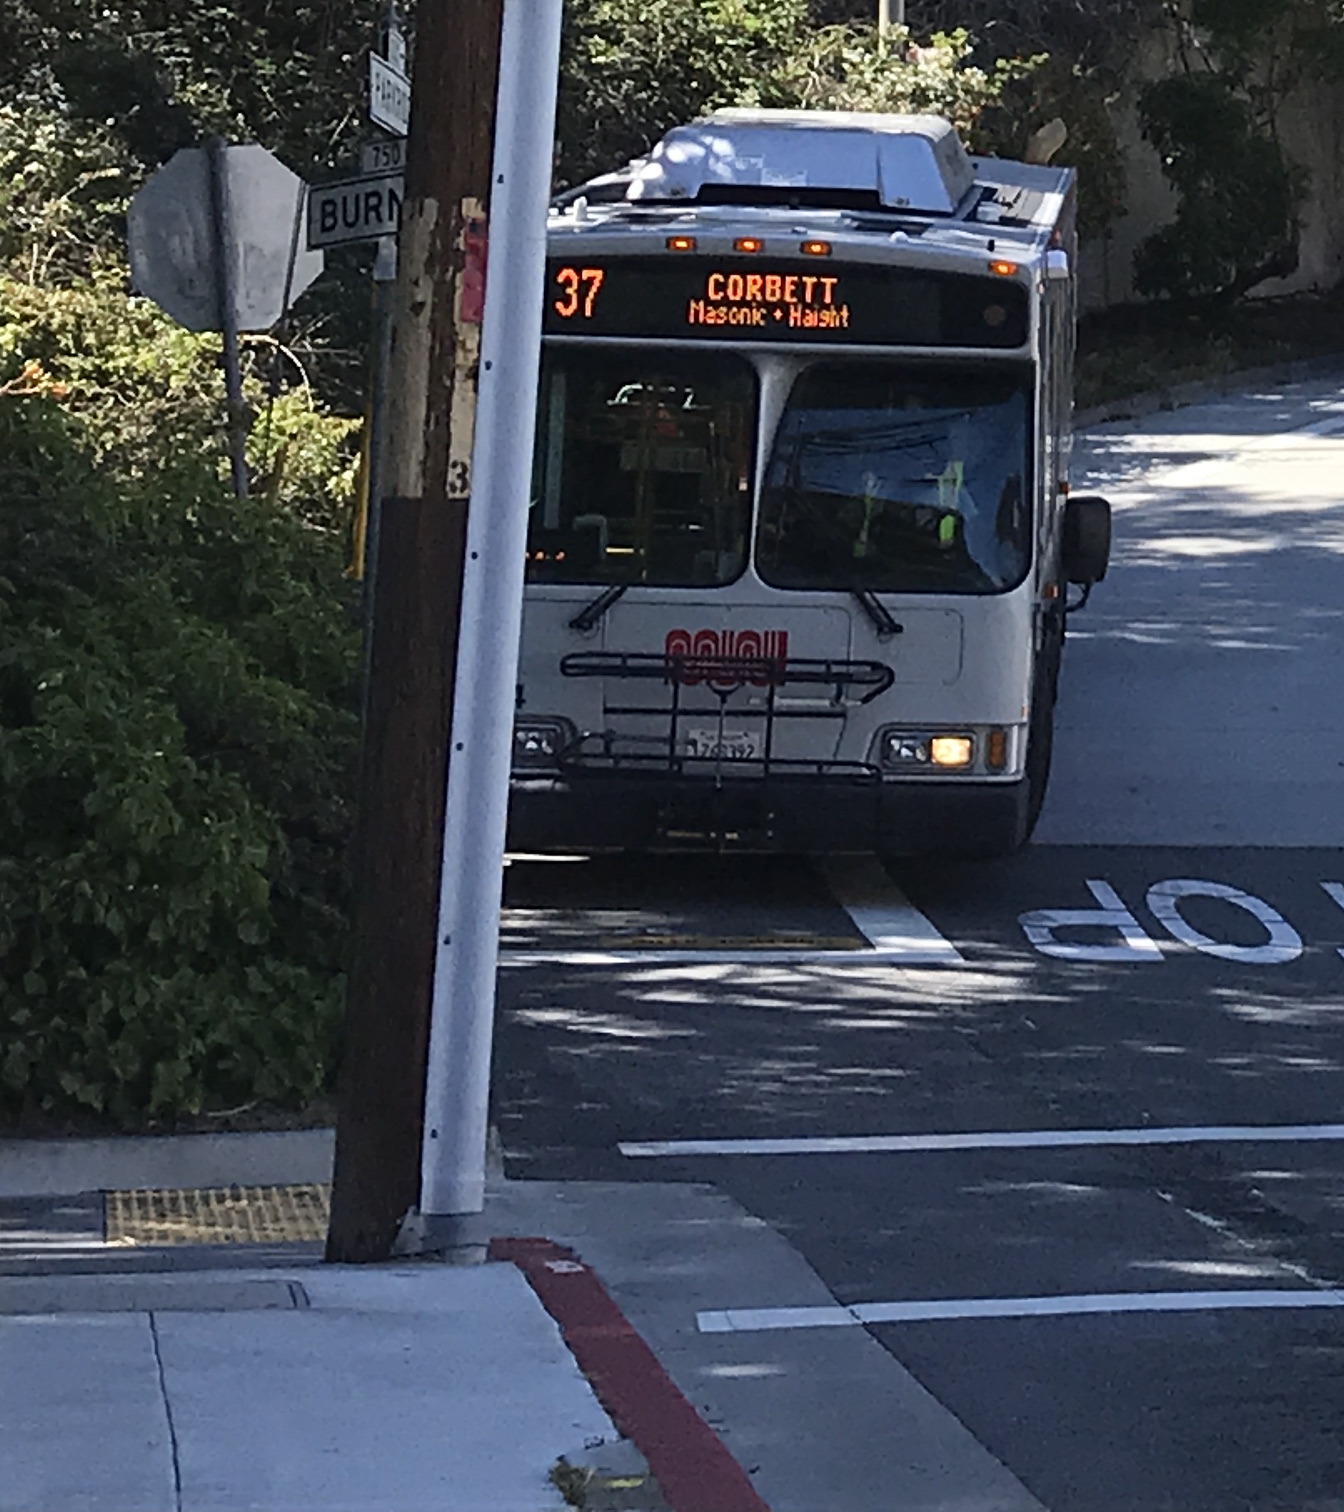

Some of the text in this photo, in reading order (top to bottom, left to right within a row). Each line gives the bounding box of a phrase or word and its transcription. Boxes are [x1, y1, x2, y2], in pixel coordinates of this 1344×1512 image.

[372, 144, 400, 167] 750
[555, 268, 604, 317] 37
[707, 273, 839, 303] CORBETT
[688, 299, 850, 328] Masonic Haight
[449, 460, 469, 494] 3
